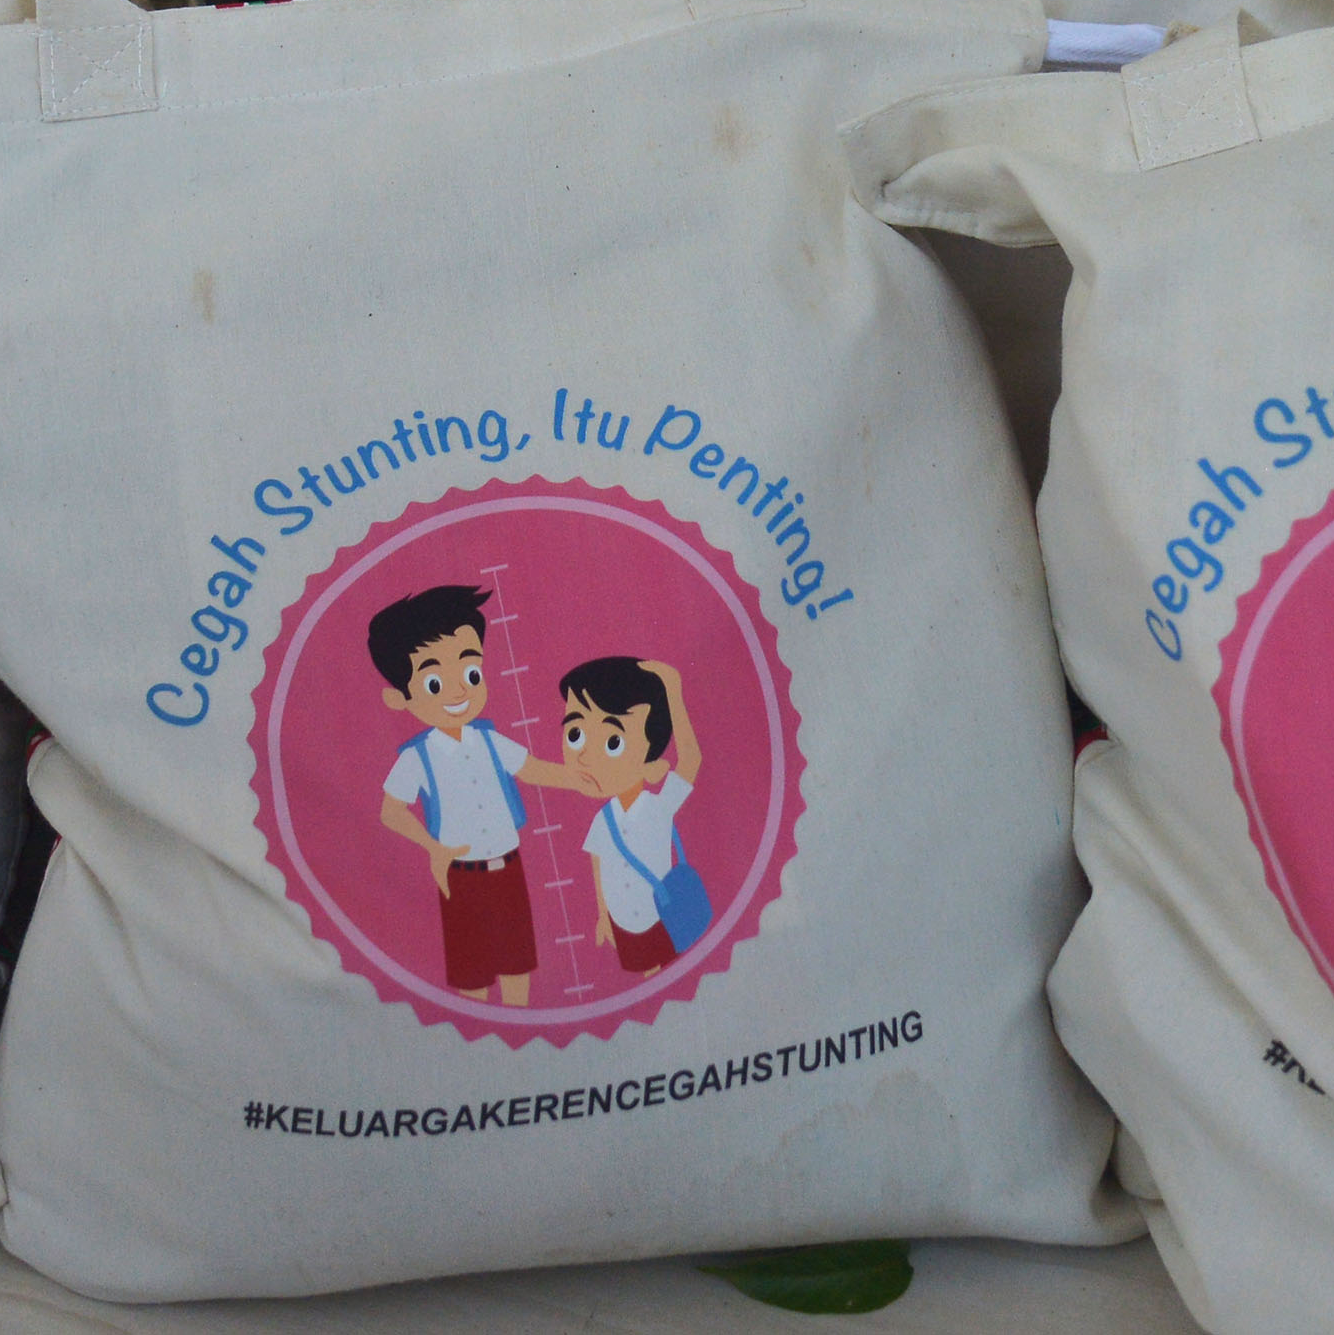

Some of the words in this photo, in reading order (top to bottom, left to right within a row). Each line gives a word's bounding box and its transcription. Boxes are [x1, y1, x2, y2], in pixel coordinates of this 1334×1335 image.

[145, 534, 267, 728] Cegah
[253, 408, 532, 537] Stunting,
[552, 387, 632, 451] Itu
[642, 404, 855, 622] Penting!
[1144, 457, 1264, 663] Cegah
[242, 1009, 925, 1139] #KELUARGAKERENCEGAHSTUNTING
